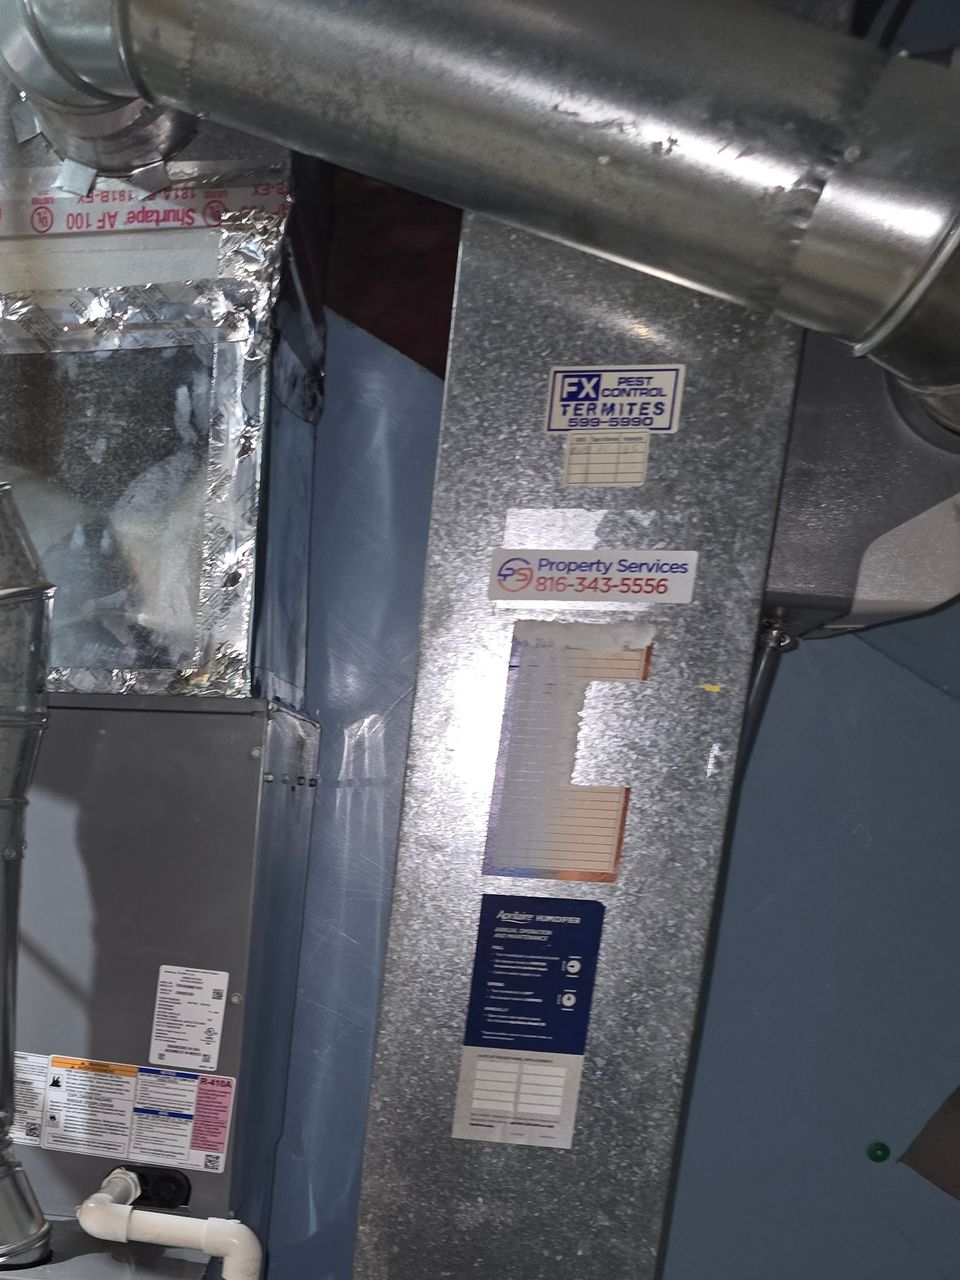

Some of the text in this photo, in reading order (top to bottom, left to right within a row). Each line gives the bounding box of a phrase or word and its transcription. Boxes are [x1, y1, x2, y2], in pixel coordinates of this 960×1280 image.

[66, 205, 196, 231] Shurtape AF 100
[562, 377, 600, 399] FX
[617, 376, 654, 387] PEST
[601, 387, 667, 398] CONTROL
[560, 402, 665, 417] TERMITES
[568, 416, 654, 428] 599-5990
[538, 558, 689, 575] Property Services
[535, 576, 669, 594] 816-343-5556
